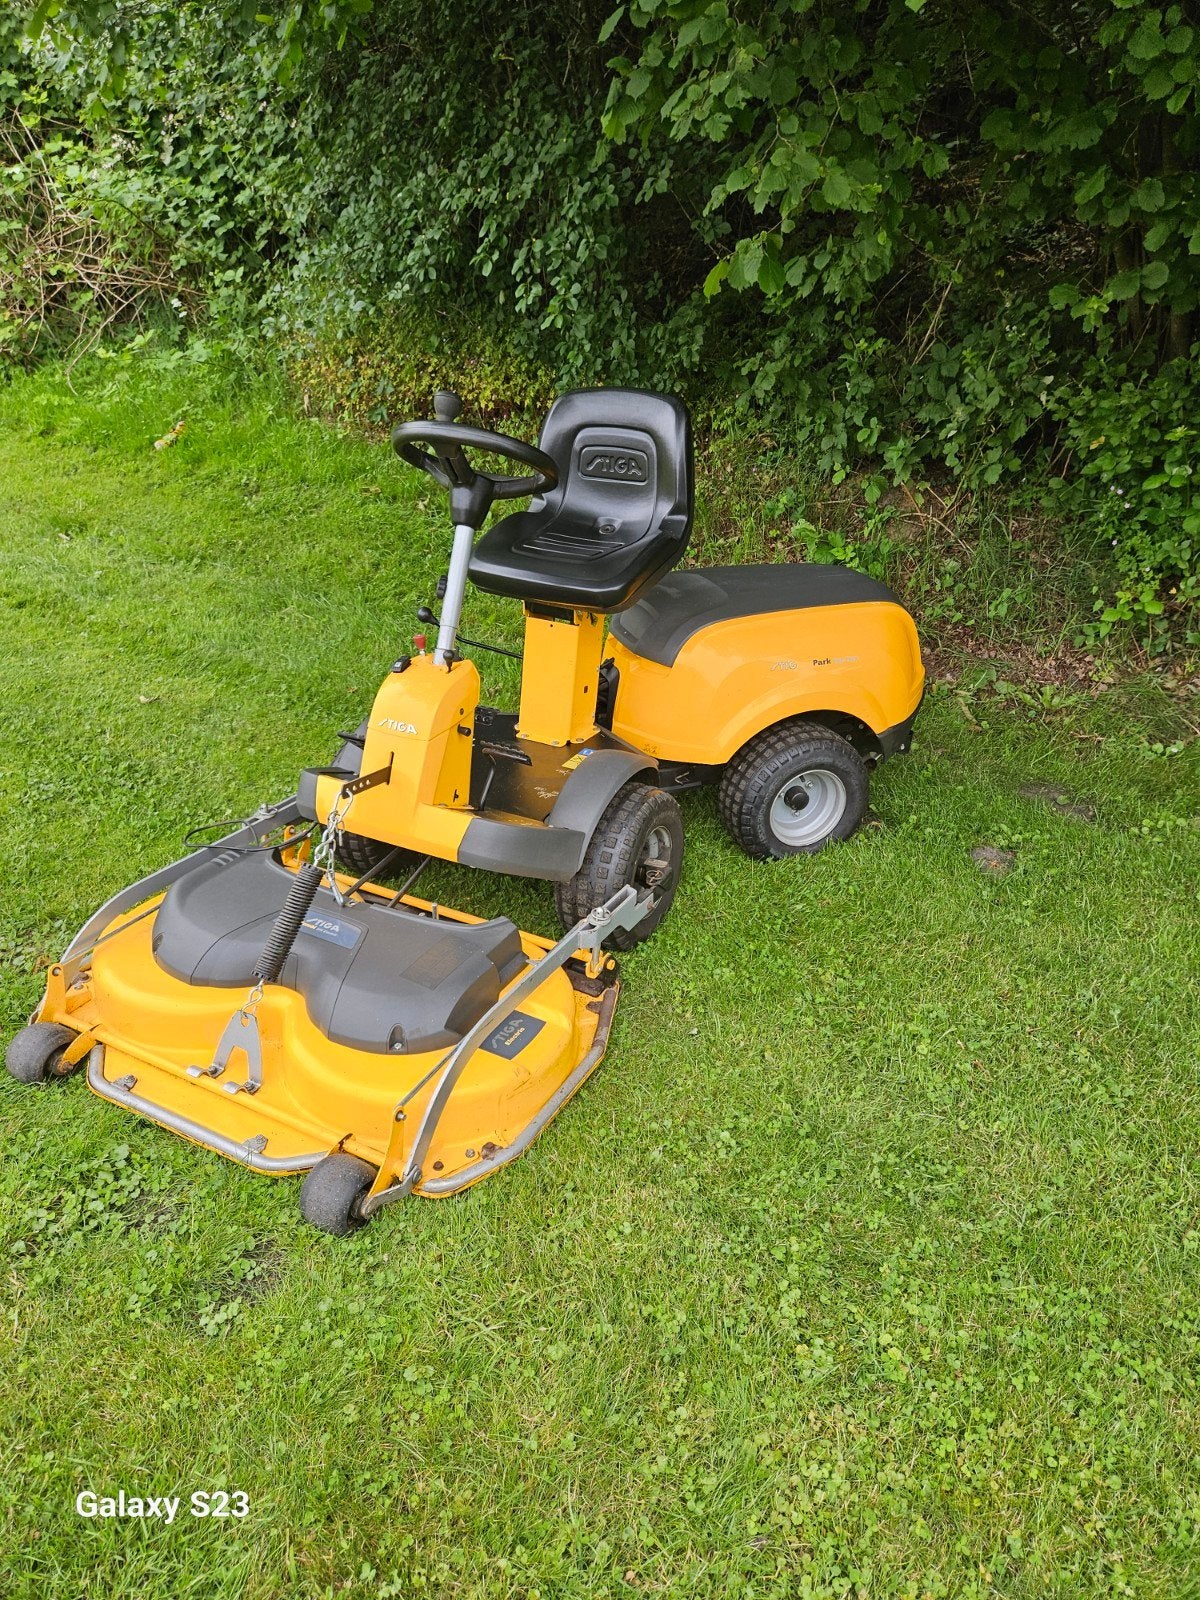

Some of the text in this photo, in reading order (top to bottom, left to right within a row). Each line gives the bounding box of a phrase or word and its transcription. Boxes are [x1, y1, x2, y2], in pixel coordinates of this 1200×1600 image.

[586, 454, 642, 476] STIGA
[813, 657, 831, 667] Park
[378, 717, 418, 735] STIGA
[306, 918, 340, 932] STIGA
[491, 1018, 524, 1049] STIGA
